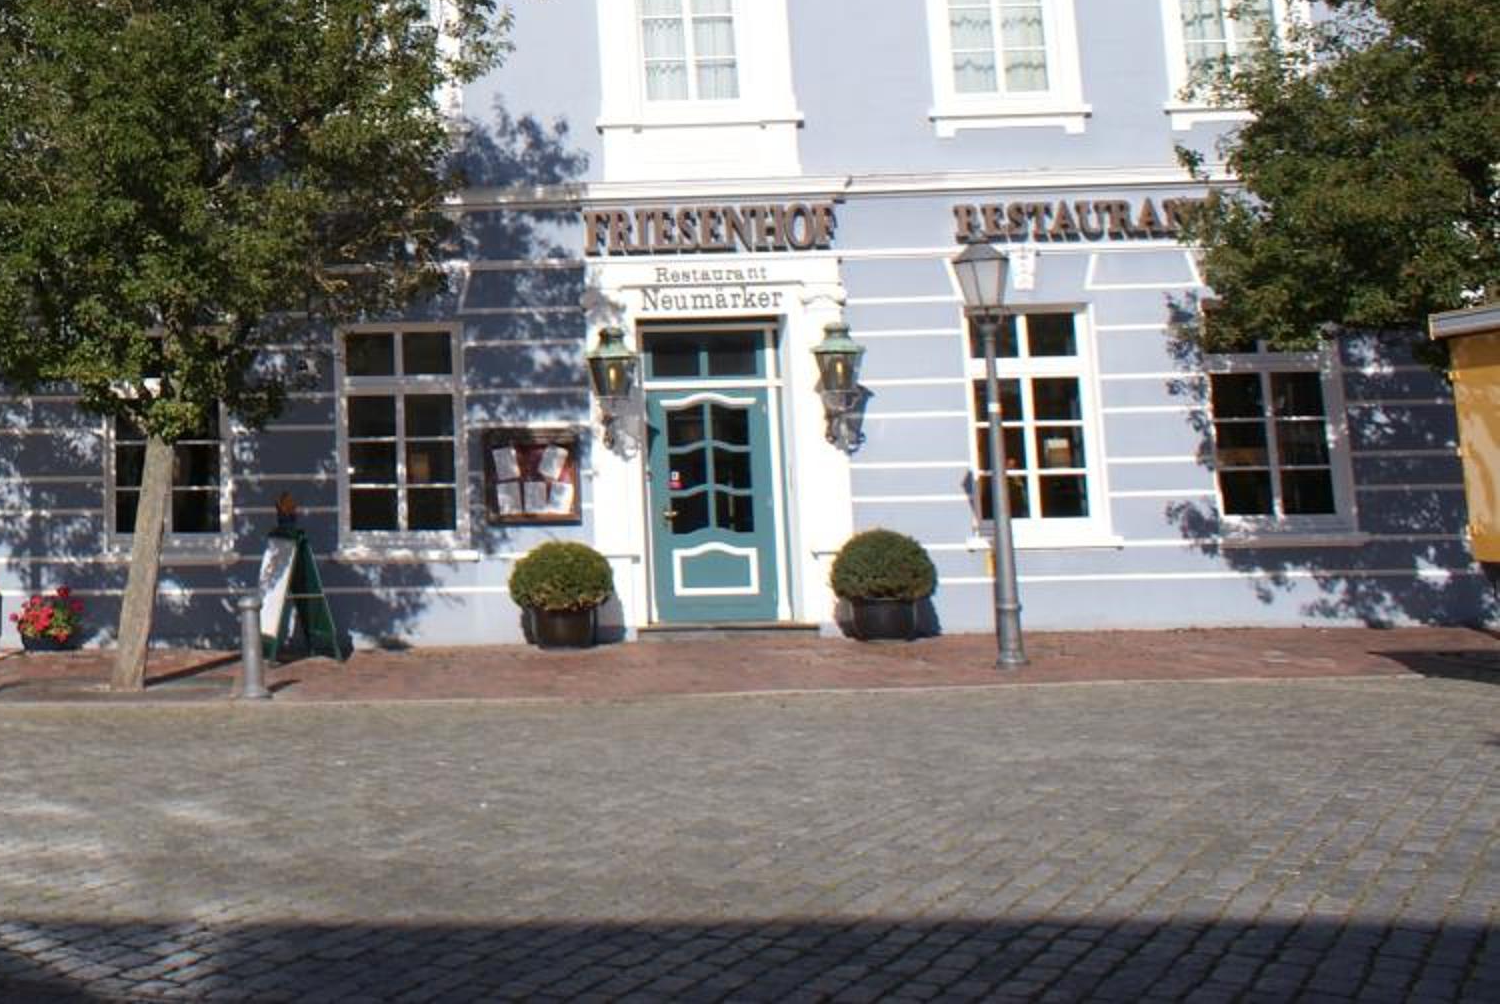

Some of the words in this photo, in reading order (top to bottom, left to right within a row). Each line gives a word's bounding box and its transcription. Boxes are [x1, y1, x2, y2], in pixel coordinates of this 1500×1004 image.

[583, 202, 838, 257] FRIESENHOF
[953, 196, 1210, 243] RESTAURAN
[655, 266, 768, 283] Restaurant
[641, 285, 783, 312] Neumärker
